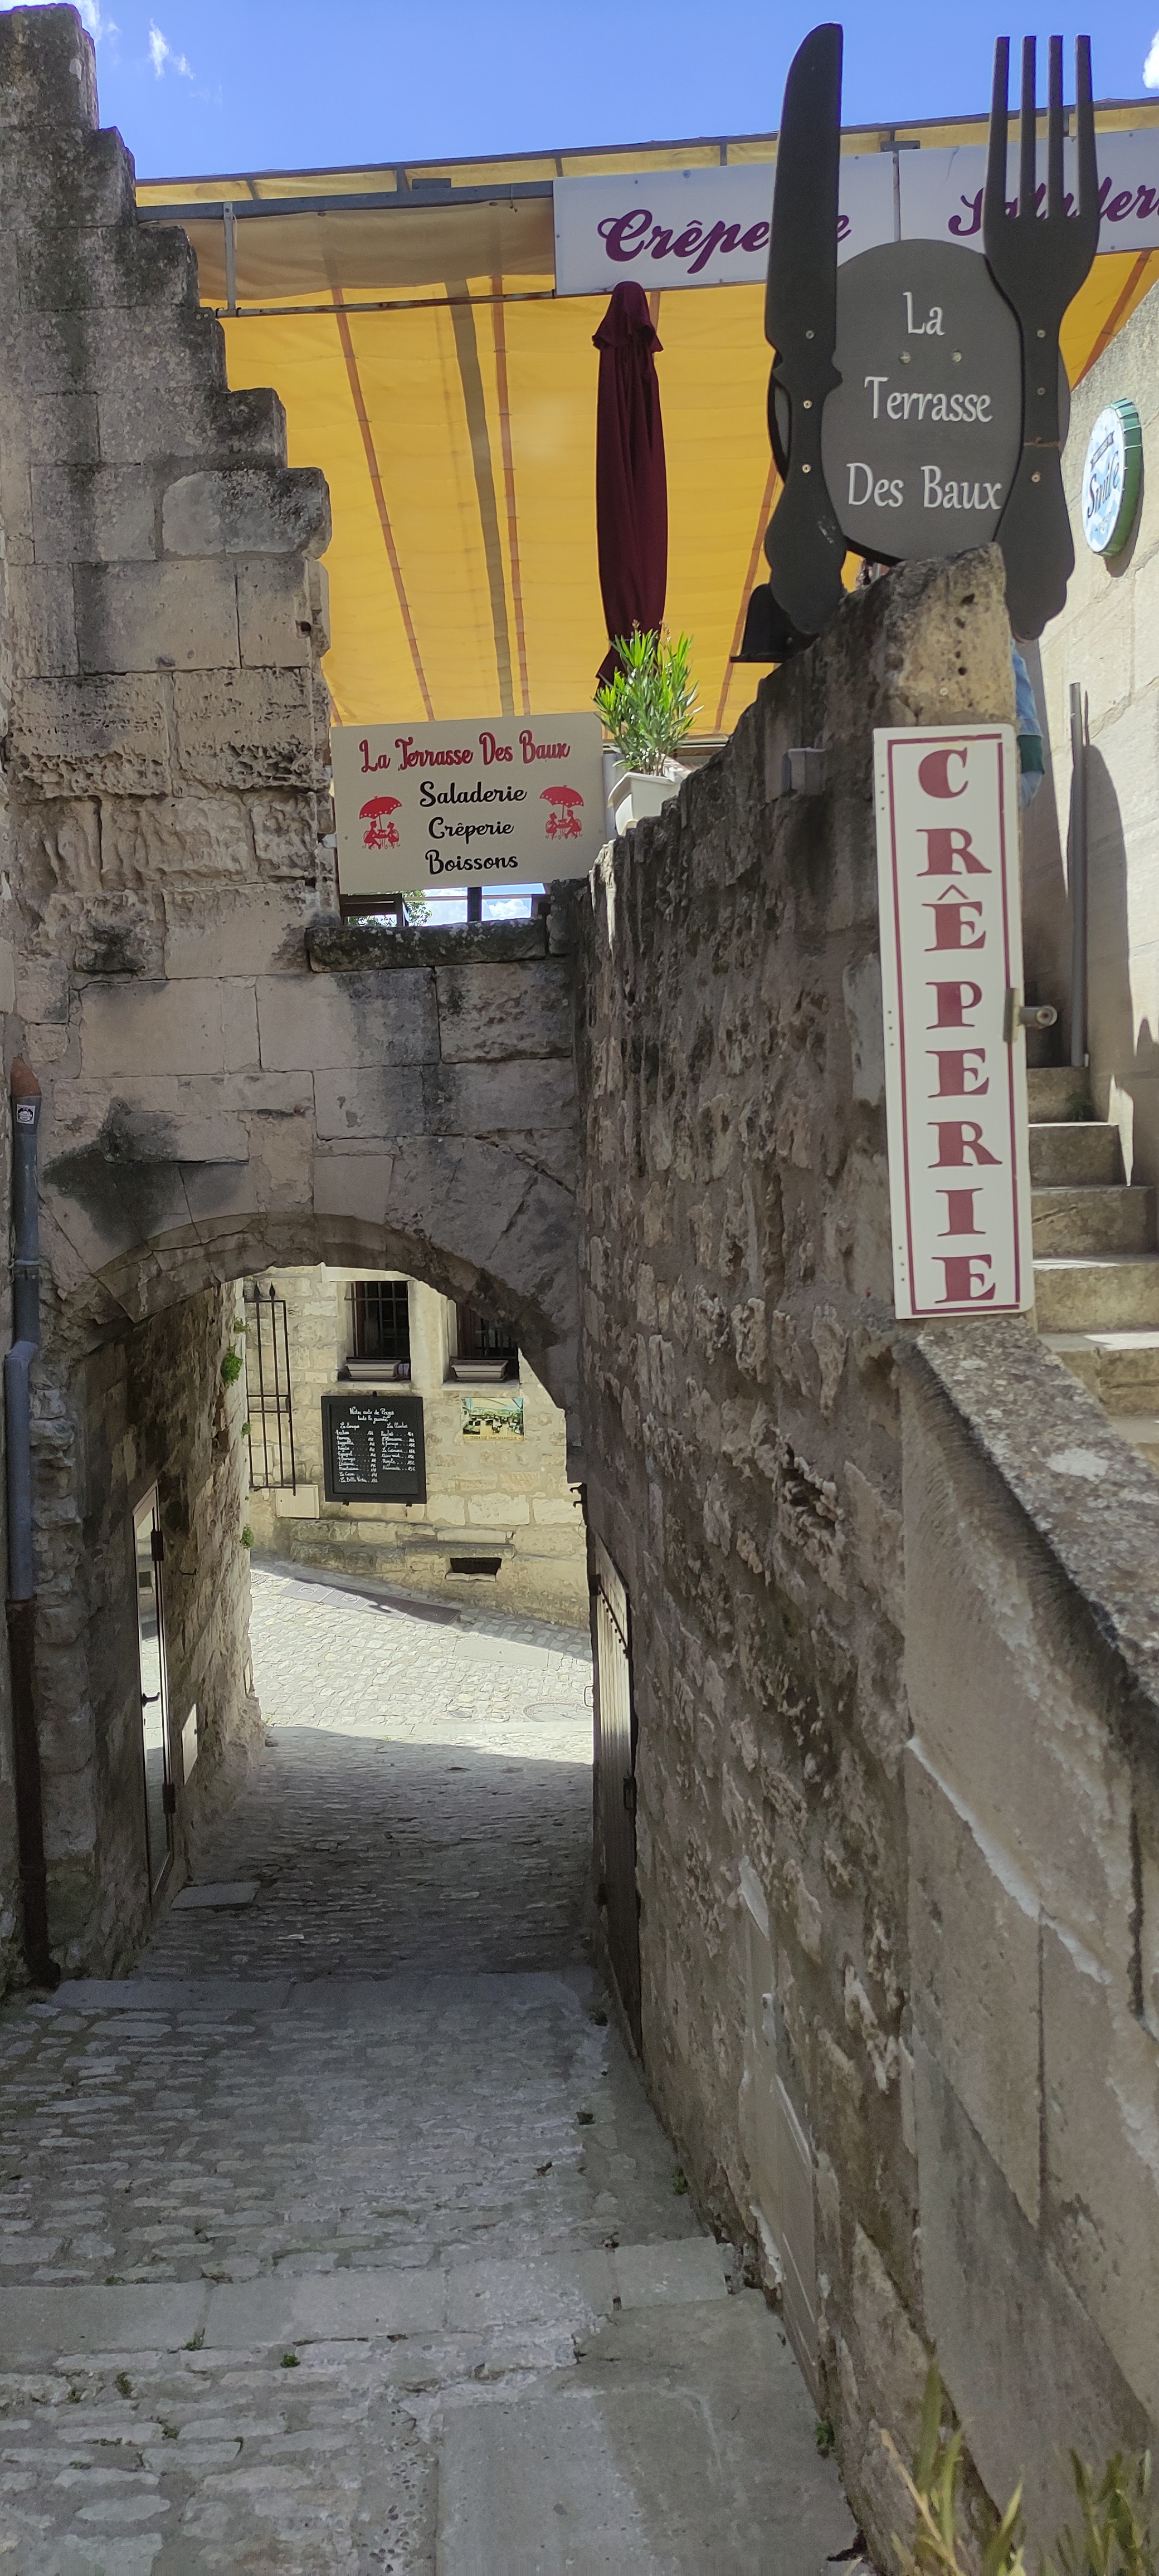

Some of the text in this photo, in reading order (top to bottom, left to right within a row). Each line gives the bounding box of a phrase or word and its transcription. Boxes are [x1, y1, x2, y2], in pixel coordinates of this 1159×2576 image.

[597, 209, 851, 274] Crêpee
[903, 291, 944, 335] La
[864, 375, 993, 423] Terrasse
[846, 462, 1002, 510] Des Baux
[359, 730, 570, 773] La Terrasse Des Baux
[420, 780, 527, 807] Saladerie
[428, 817, 514, 844] Crêperie
[425, 849, 518, 875] Boissons
[917, 747, 1003, 1304] CRÊPERIE
